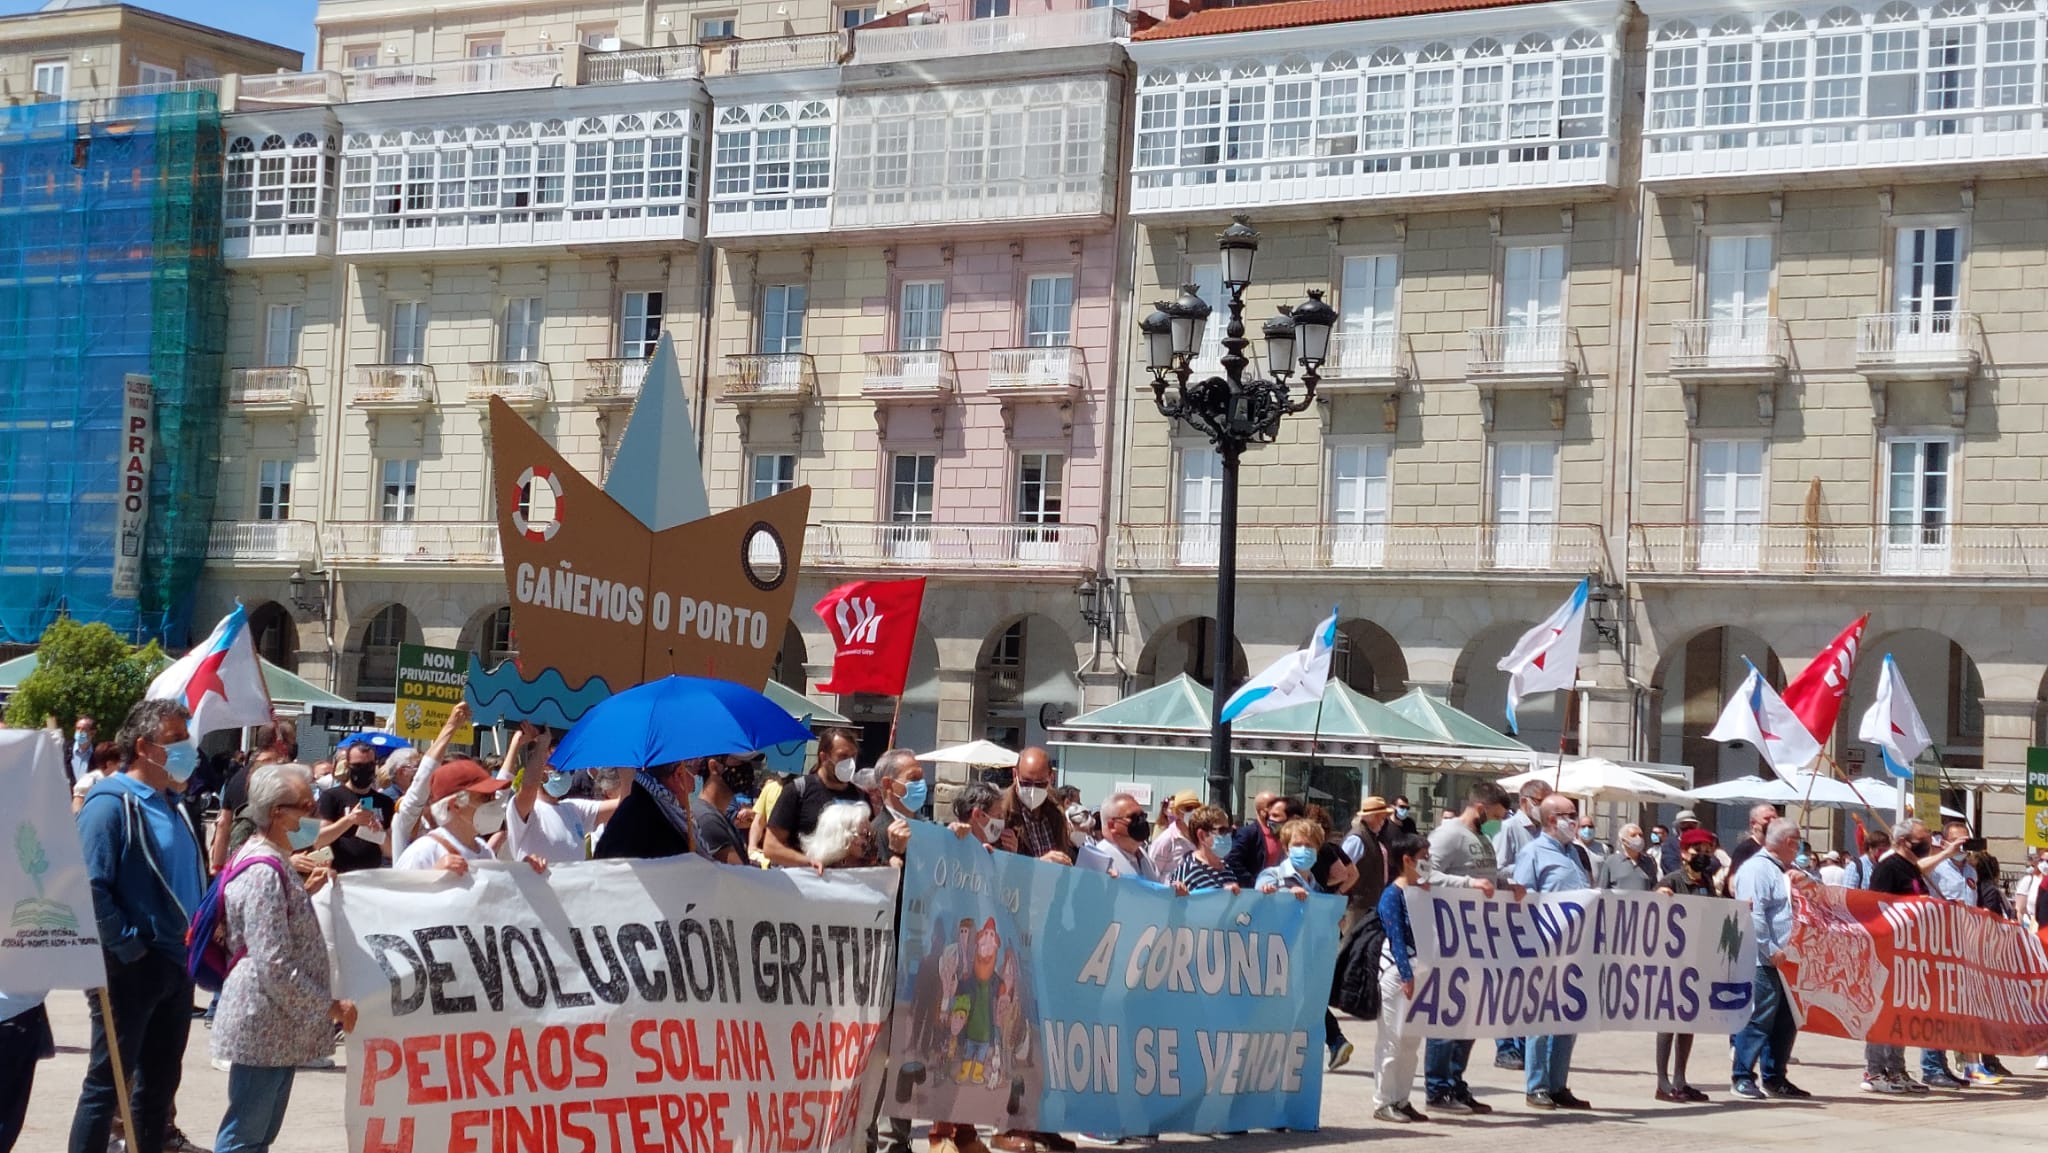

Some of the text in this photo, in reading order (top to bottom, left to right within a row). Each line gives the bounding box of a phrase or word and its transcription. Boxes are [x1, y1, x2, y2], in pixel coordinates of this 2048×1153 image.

[125, 416, 146, 512] PRADO
[516, 560, 768, 649] GAÑEMOS O PORTO
[400, 667, 468, 685] PRIVATIZACIÓ
[404, 682, 423, 695] DO
[423, 653, 455, 670] NON
[364, 903, 741, 1017] DEVOLUCIÓN
[1076, 912, 1289, 997] A CORUÑA
[1893, 955, 1931, 1011] DOS
[1406, 966, 1470, 1027] AS
[1475, 963, 1588, 1026] NOSAS
[1889, 1015, 1903, 1039] A
[360, 1021, 608, 1107] PEIRAOS
[632, 1018, 775, 1084] SOLANA
[1043, 1019, 1309, 1096] NON SE VENDE
[448, 1092, 732, 1153] FINISTERRE
